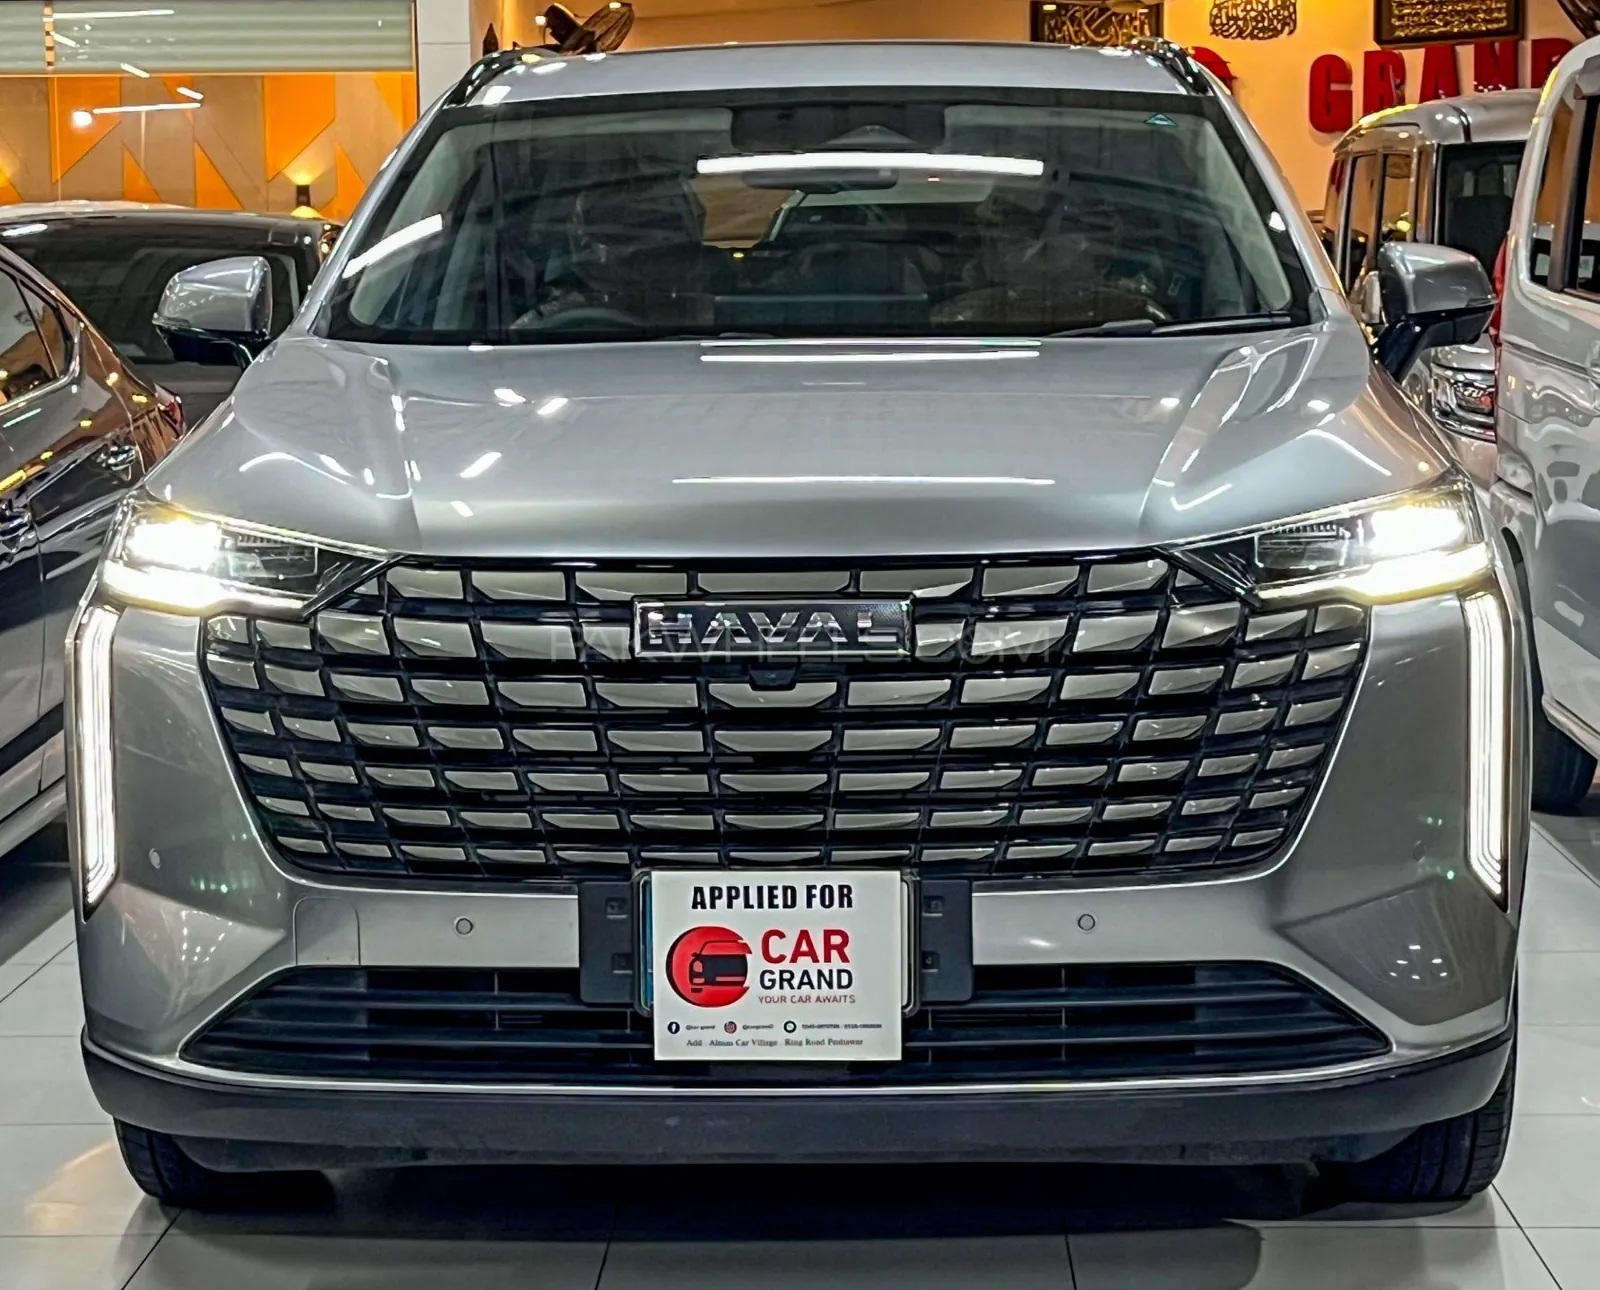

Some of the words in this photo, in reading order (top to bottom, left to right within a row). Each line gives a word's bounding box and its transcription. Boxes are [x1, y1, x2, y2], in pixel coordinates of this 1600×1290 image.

[648, 611, 898, 645] HAVAL
[691, 885, 798, 910] APPLIED
[806, 884, 853, 909] FOR
[761, 929, 850, 964] CAR
[759, 969, 854, 990] GRAND
[758, 996, 787, 1004] YOUR
[790, 995, 812, 1004] CAR
[815, 995, 856, 1004] AWAITS
